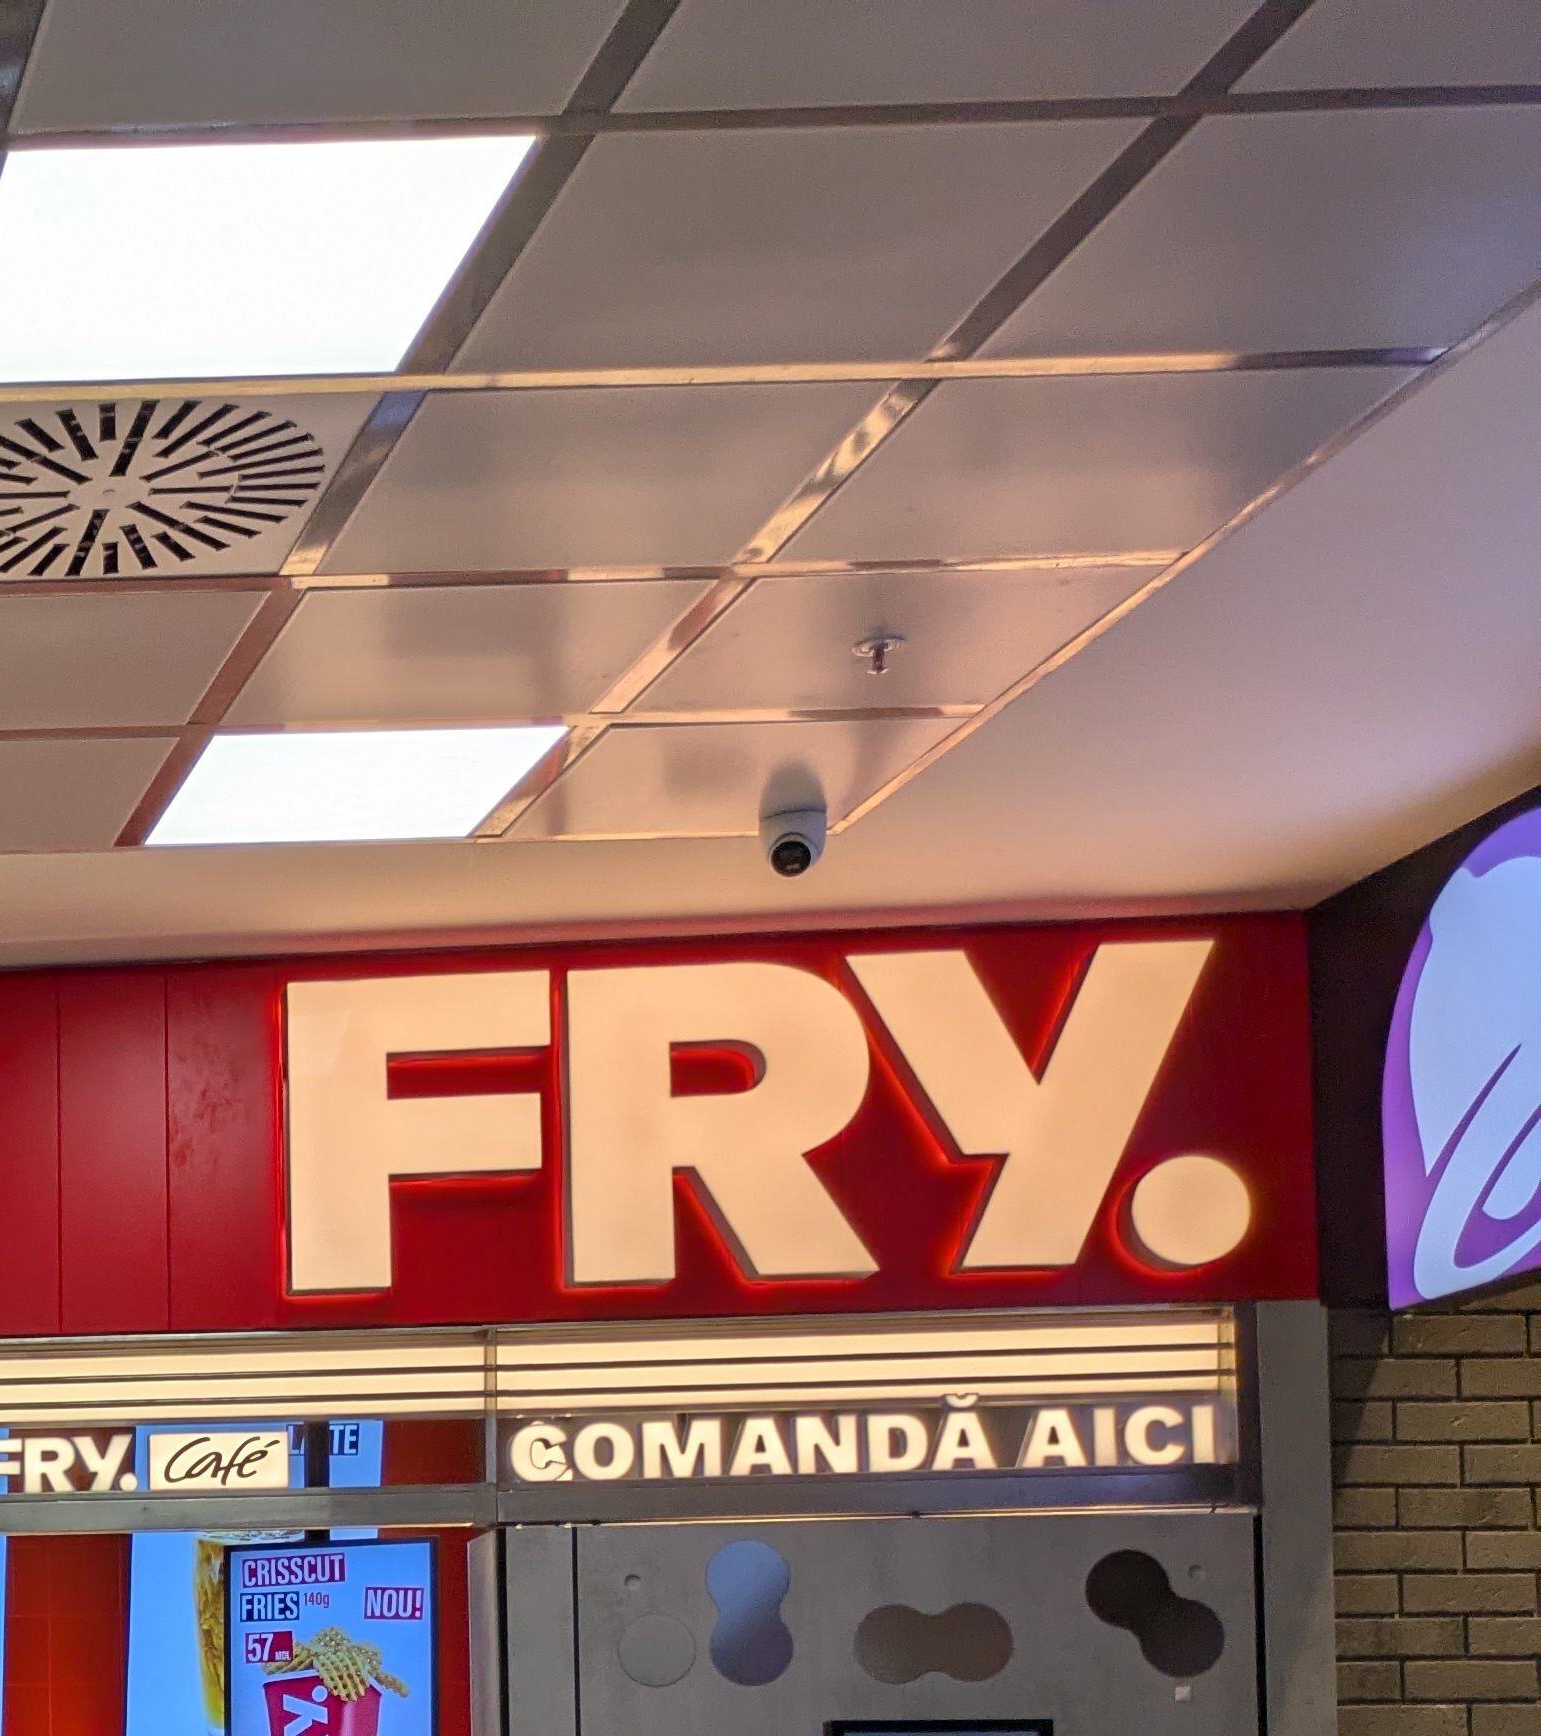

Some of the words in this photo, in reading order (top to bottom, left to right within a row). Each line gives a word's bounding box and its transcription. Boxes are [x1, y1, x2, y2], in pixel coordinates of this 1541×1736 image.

[286, 939, 1252, 1296] FRY.
[288, 1424, 357, 1454] LTE
[508, 1393, 997, 1482] COMANDĂ
[1022, 1405, 1216, 1469] AICI
[163, 1436, 281, 1485] Café
[243, 1554, 344, 1587] CRISSCUT
[241, 1592, 298, 1620] FRIES
[304, 1592, 330, 1608] 140g
[366, 1589, 422, 1618] NOU!
[247, 1633, 274, 1662] 57
